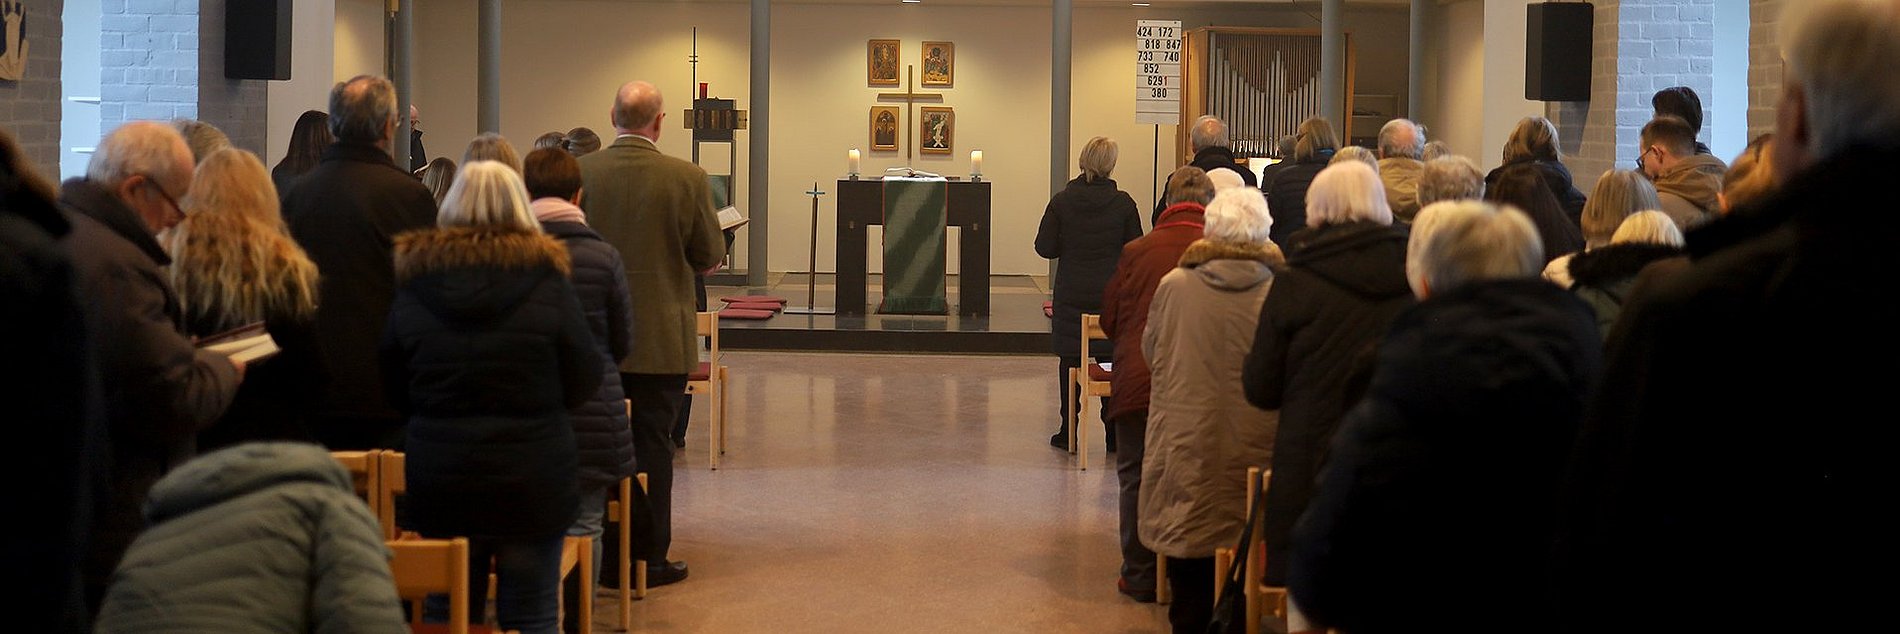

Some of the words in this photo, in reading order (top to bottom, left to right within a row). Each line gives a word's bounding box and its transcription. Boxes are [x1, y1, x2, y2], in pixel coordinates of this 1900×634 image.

[1137, 27, 1152, 37] 424
[1159, 27, 1173, 37] 172
[1145, 39, 1160, 49] 818
[1166, 40, 1181, 50] 847
[1138, 51, 1153, 61] 733
[1164, 52, 1179, 62] 740
[1144, 64, 1159, 73] 852
[1152, 88, 1167, 98] 380
